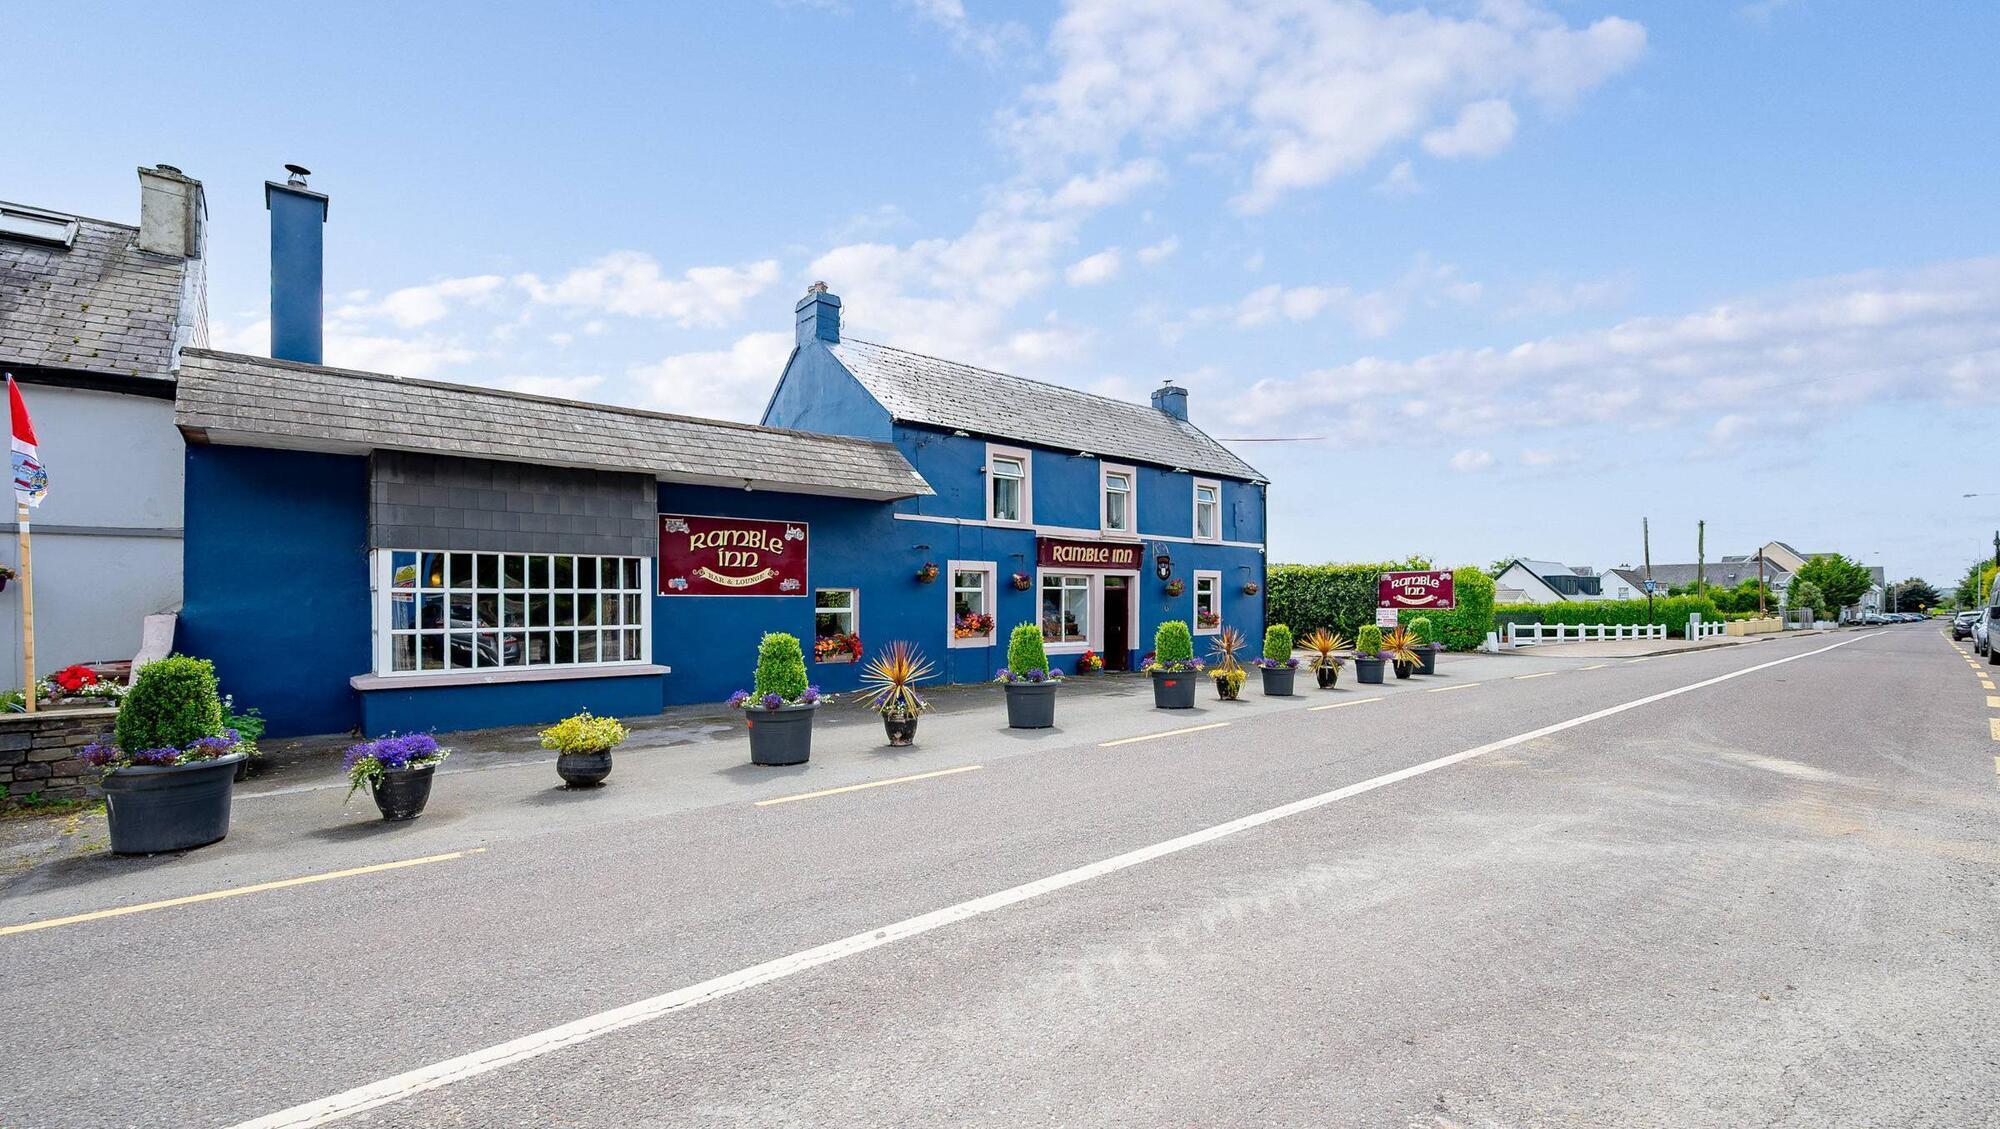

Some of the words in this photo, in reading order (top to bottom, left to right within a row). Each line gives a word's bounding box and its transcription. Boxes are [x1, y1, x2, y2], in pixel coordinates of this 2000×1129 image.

[689, 529, 784, 555] Ramble
[1052, 545, 1109, 562] Ramble
[1112, 548, 1133, 563] Inn
[708, 572, 725, 584] BAR
[735, 572, 765, 585] LOUNGE
[1391, 575, 1440, 589] Ramble
[1404, 585, 1425, 596] Inn
